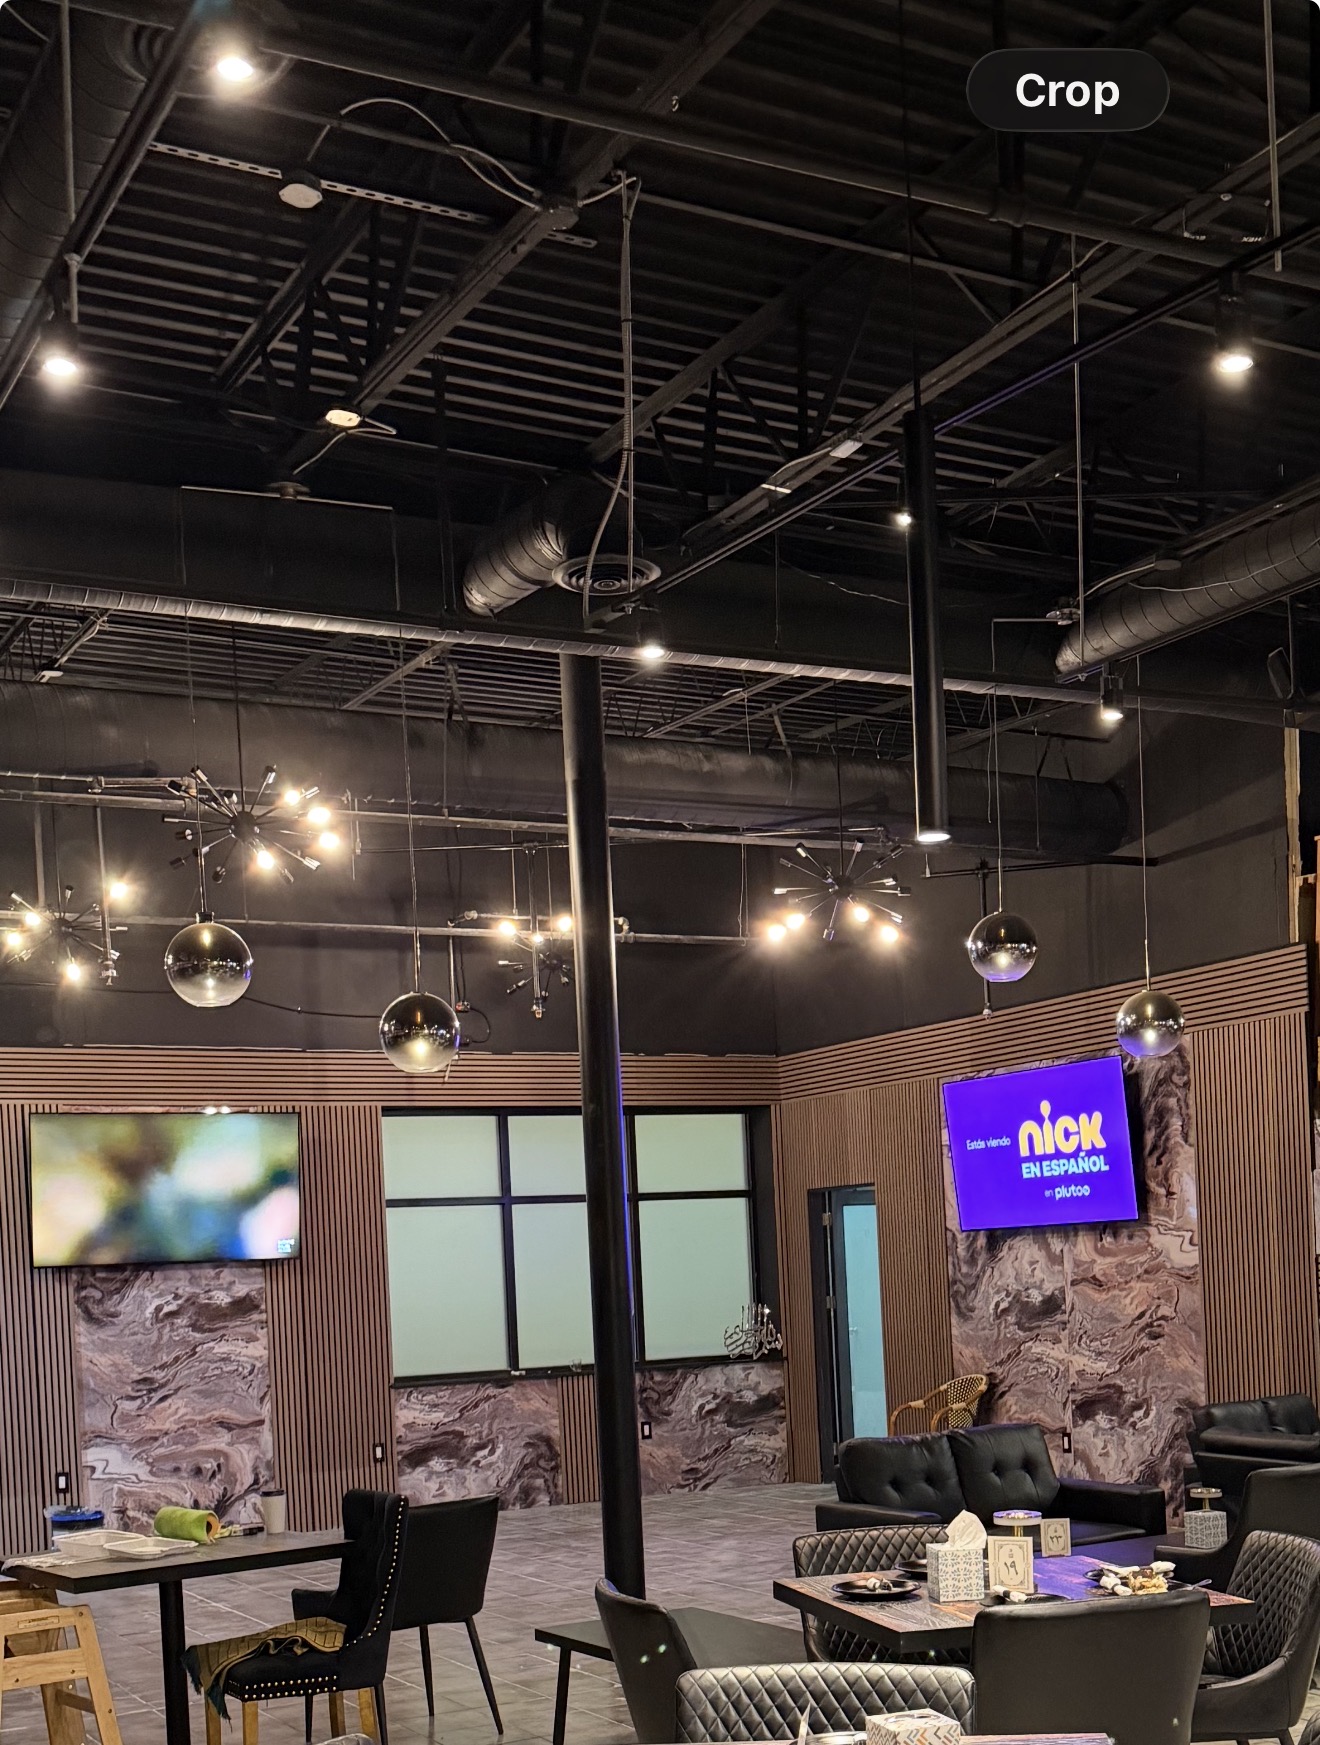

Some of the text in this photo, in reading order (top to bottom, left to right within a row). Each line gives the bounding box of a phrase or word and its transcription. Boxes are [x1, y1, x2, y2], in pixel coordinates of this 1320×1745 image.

[966, 1136, 1011, 1151] Estás viendo
[1022, 1151, 1110, 1179] EN ESPAÑOL
[1044, 1189, 1054, 1198] en
